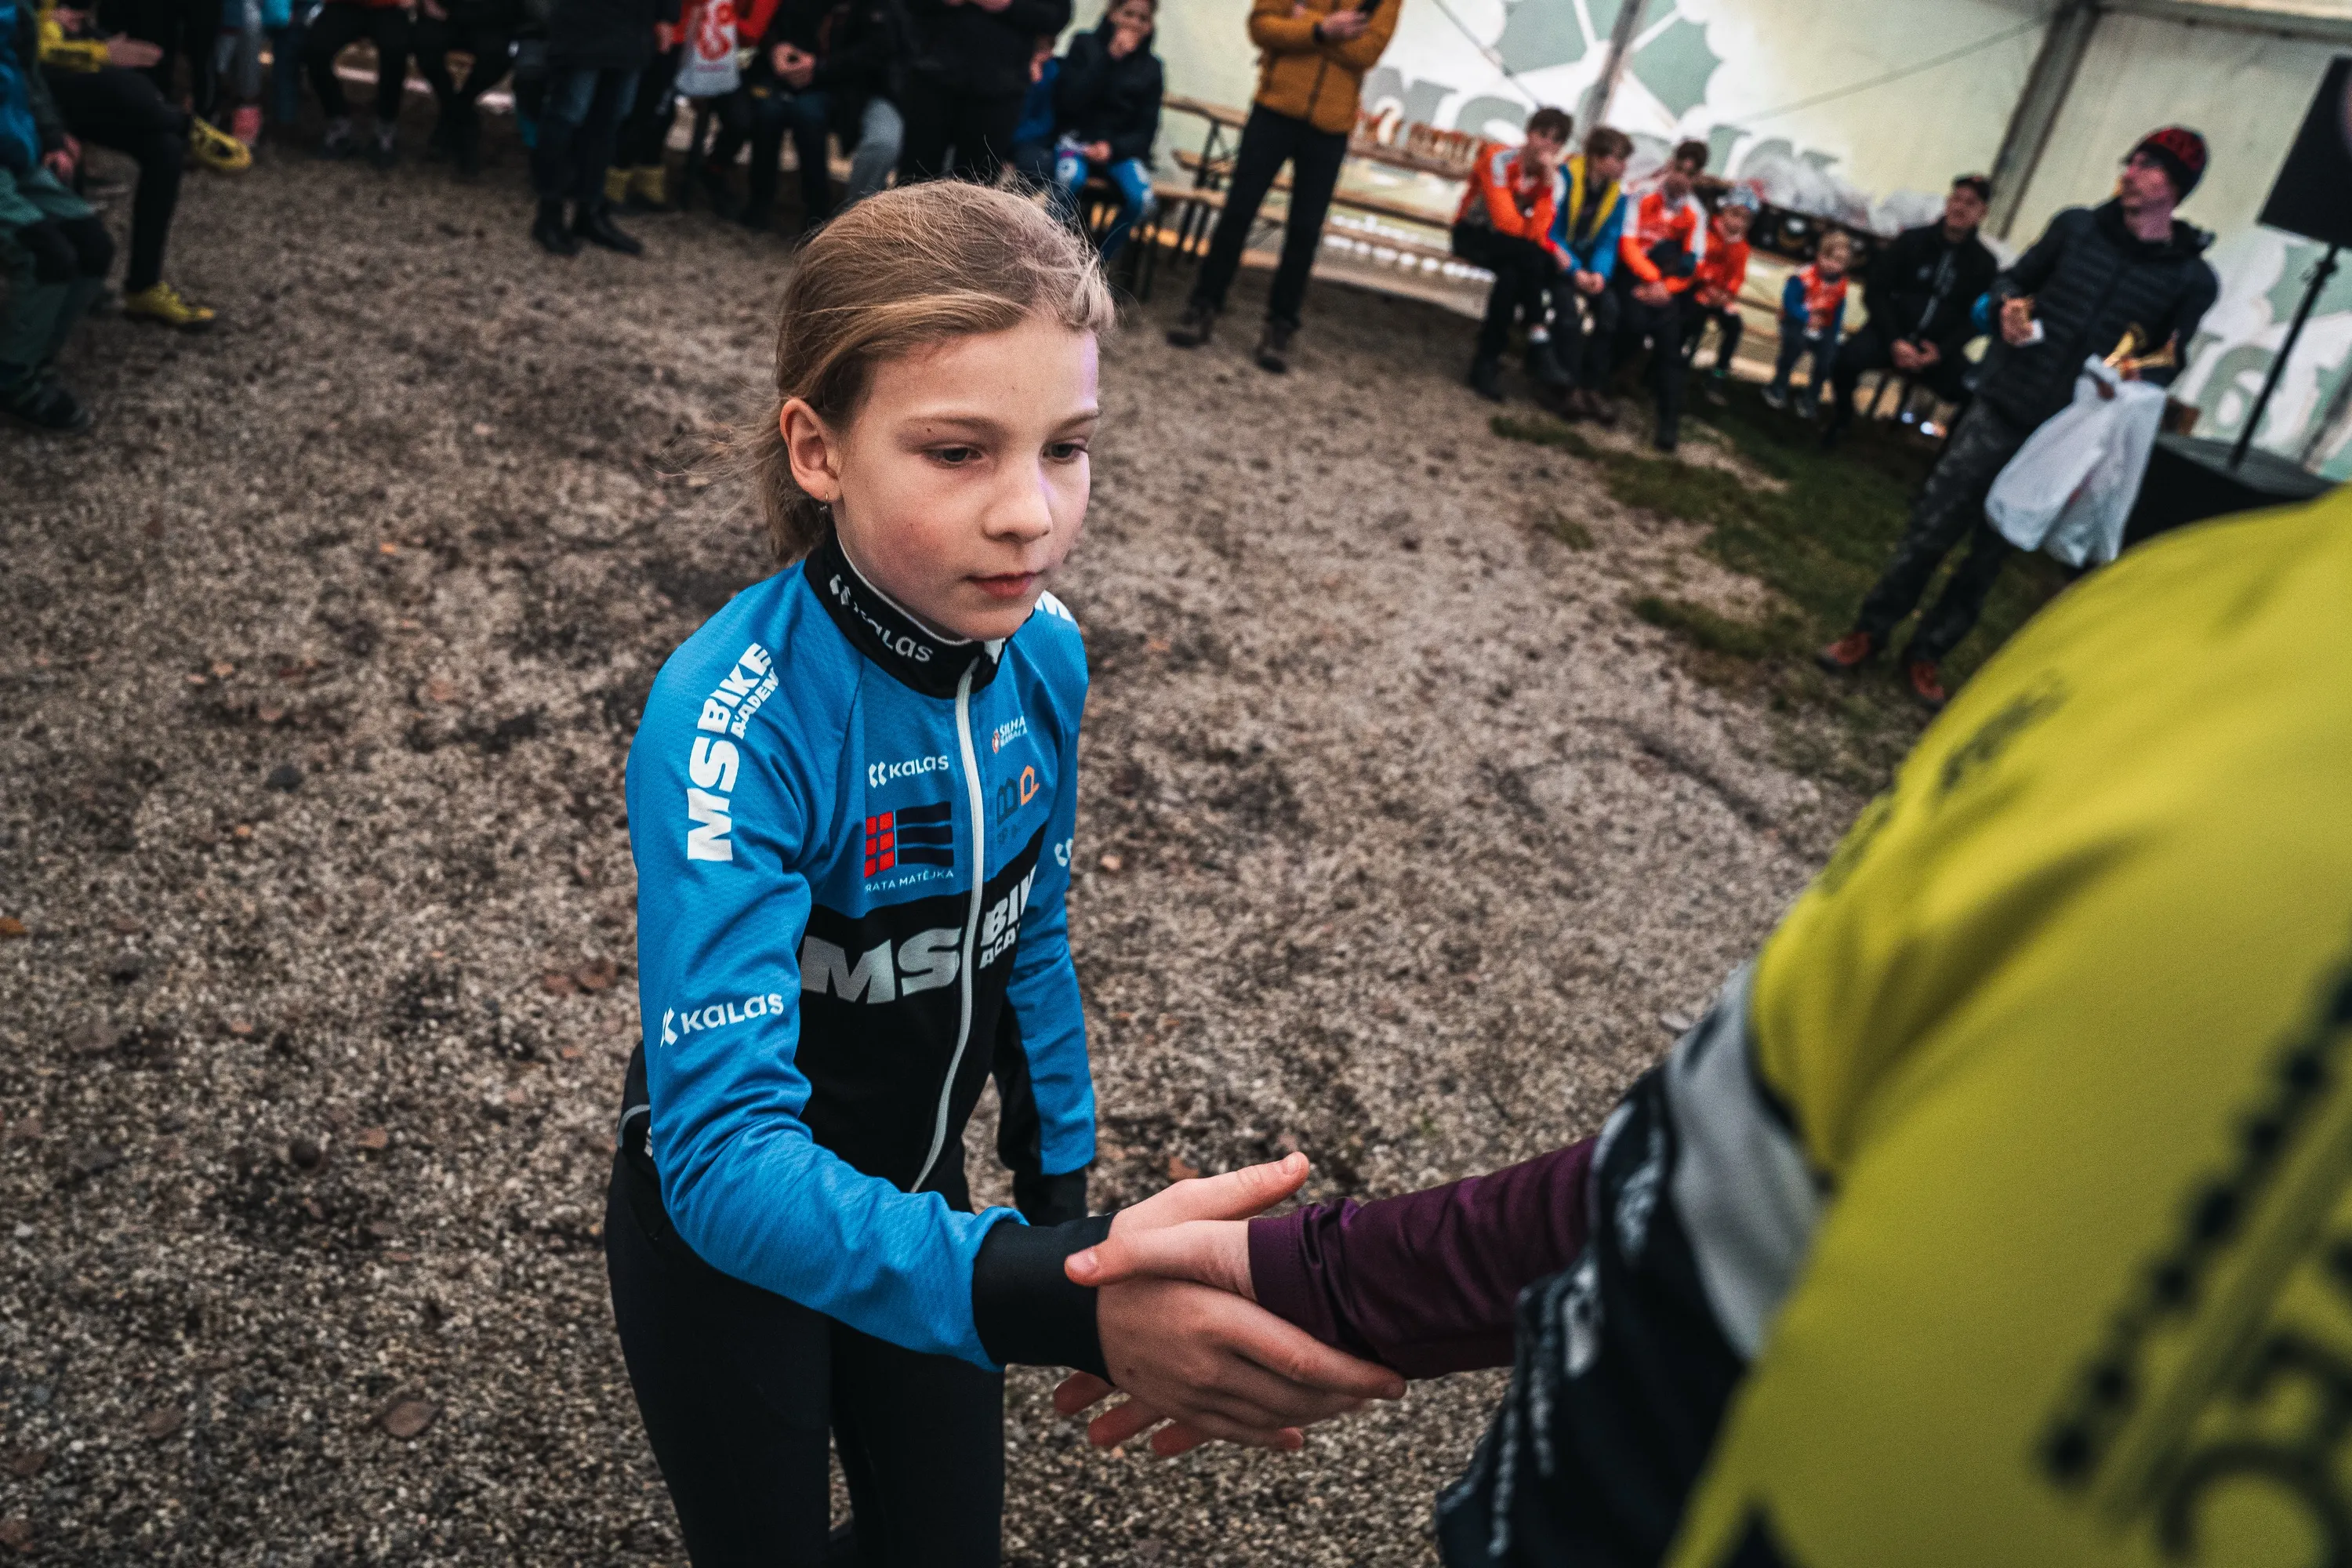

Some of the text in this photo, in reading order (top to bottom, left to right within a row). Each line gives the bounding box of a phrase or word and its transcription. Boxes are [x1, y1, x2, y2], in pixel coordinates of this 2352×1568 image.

[687, 642, 772, 862] MS BIKE
[899, 869, 954, 887] MATĚJKA
[800, 927, 961, 1004] MS
